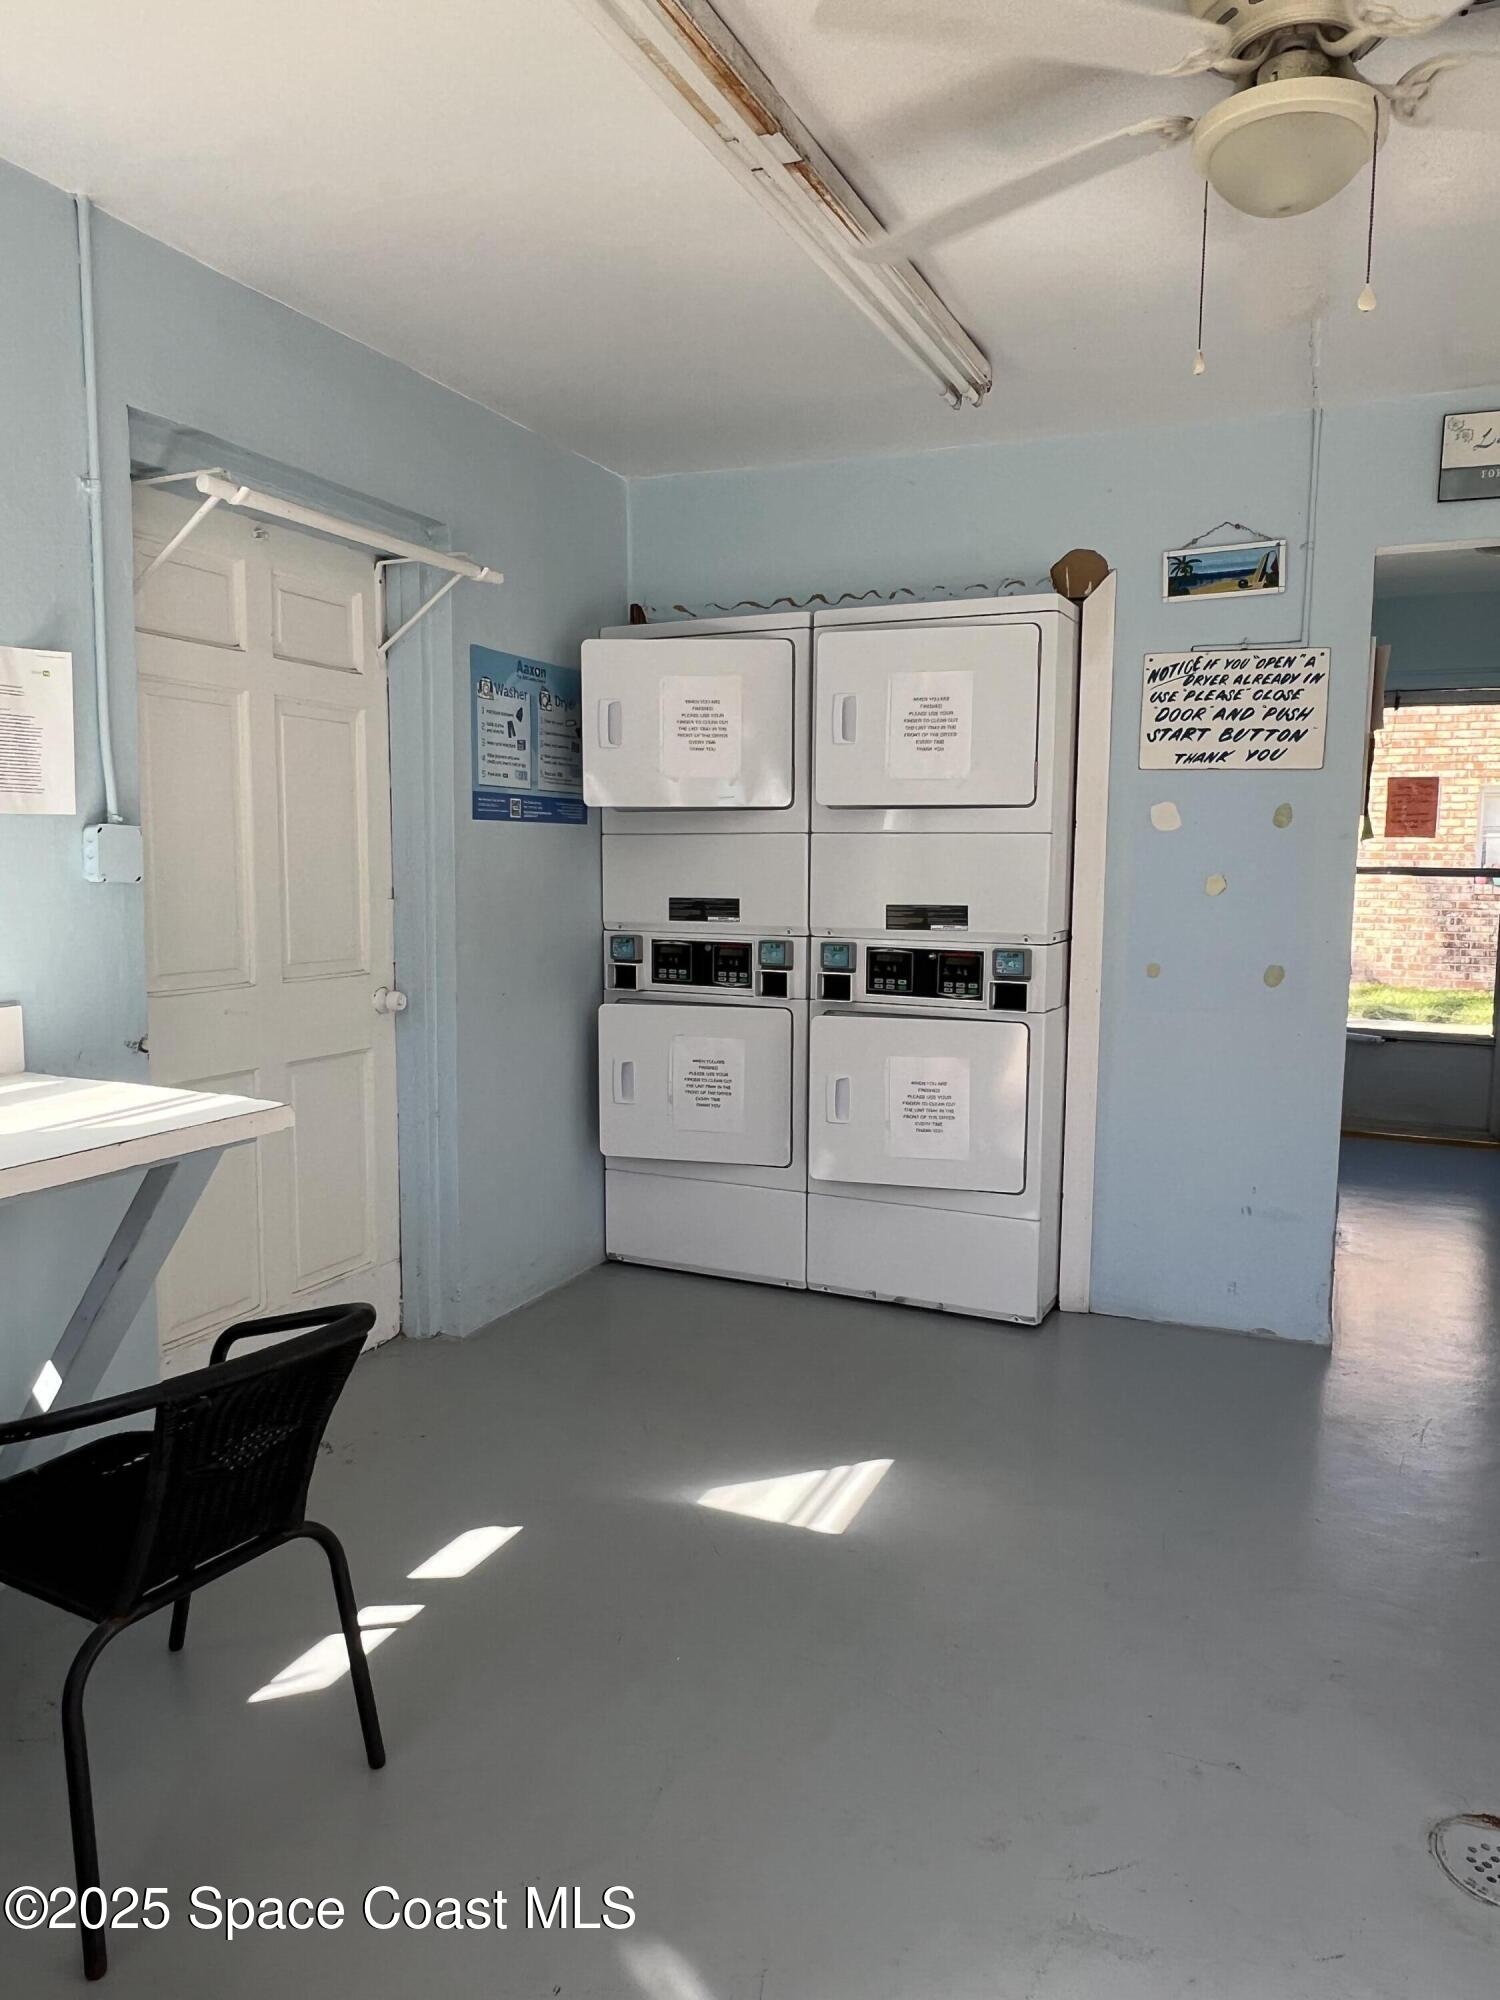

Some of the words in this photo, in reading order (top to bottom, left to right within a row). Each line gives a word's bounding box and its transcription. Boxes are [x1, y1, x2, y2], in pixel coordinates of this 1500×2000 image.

[516, 660, 546, 678] Aaxon
[1203, 658, 1221, 670] IF
[1224, 658, 1250, 670] YOU
[1304, 656, 1317, 667] A
[1182, 674, 1230, 686] DRYER
[1233, 673, 1301, 685] ALREADY
[1303, 672, 1325, 684] IN
[494, 682, 528, 701] Washer
[1150, 691, 1179, 703] USE
[1252, 688, 1305, 701] CLOSE
[1212, 708, 1255, 721] AND
[1147, 728, 1211, 742] START
[1174, 750, 1235, 764] THANK
[1245, 748, 1288, 762] YOU
